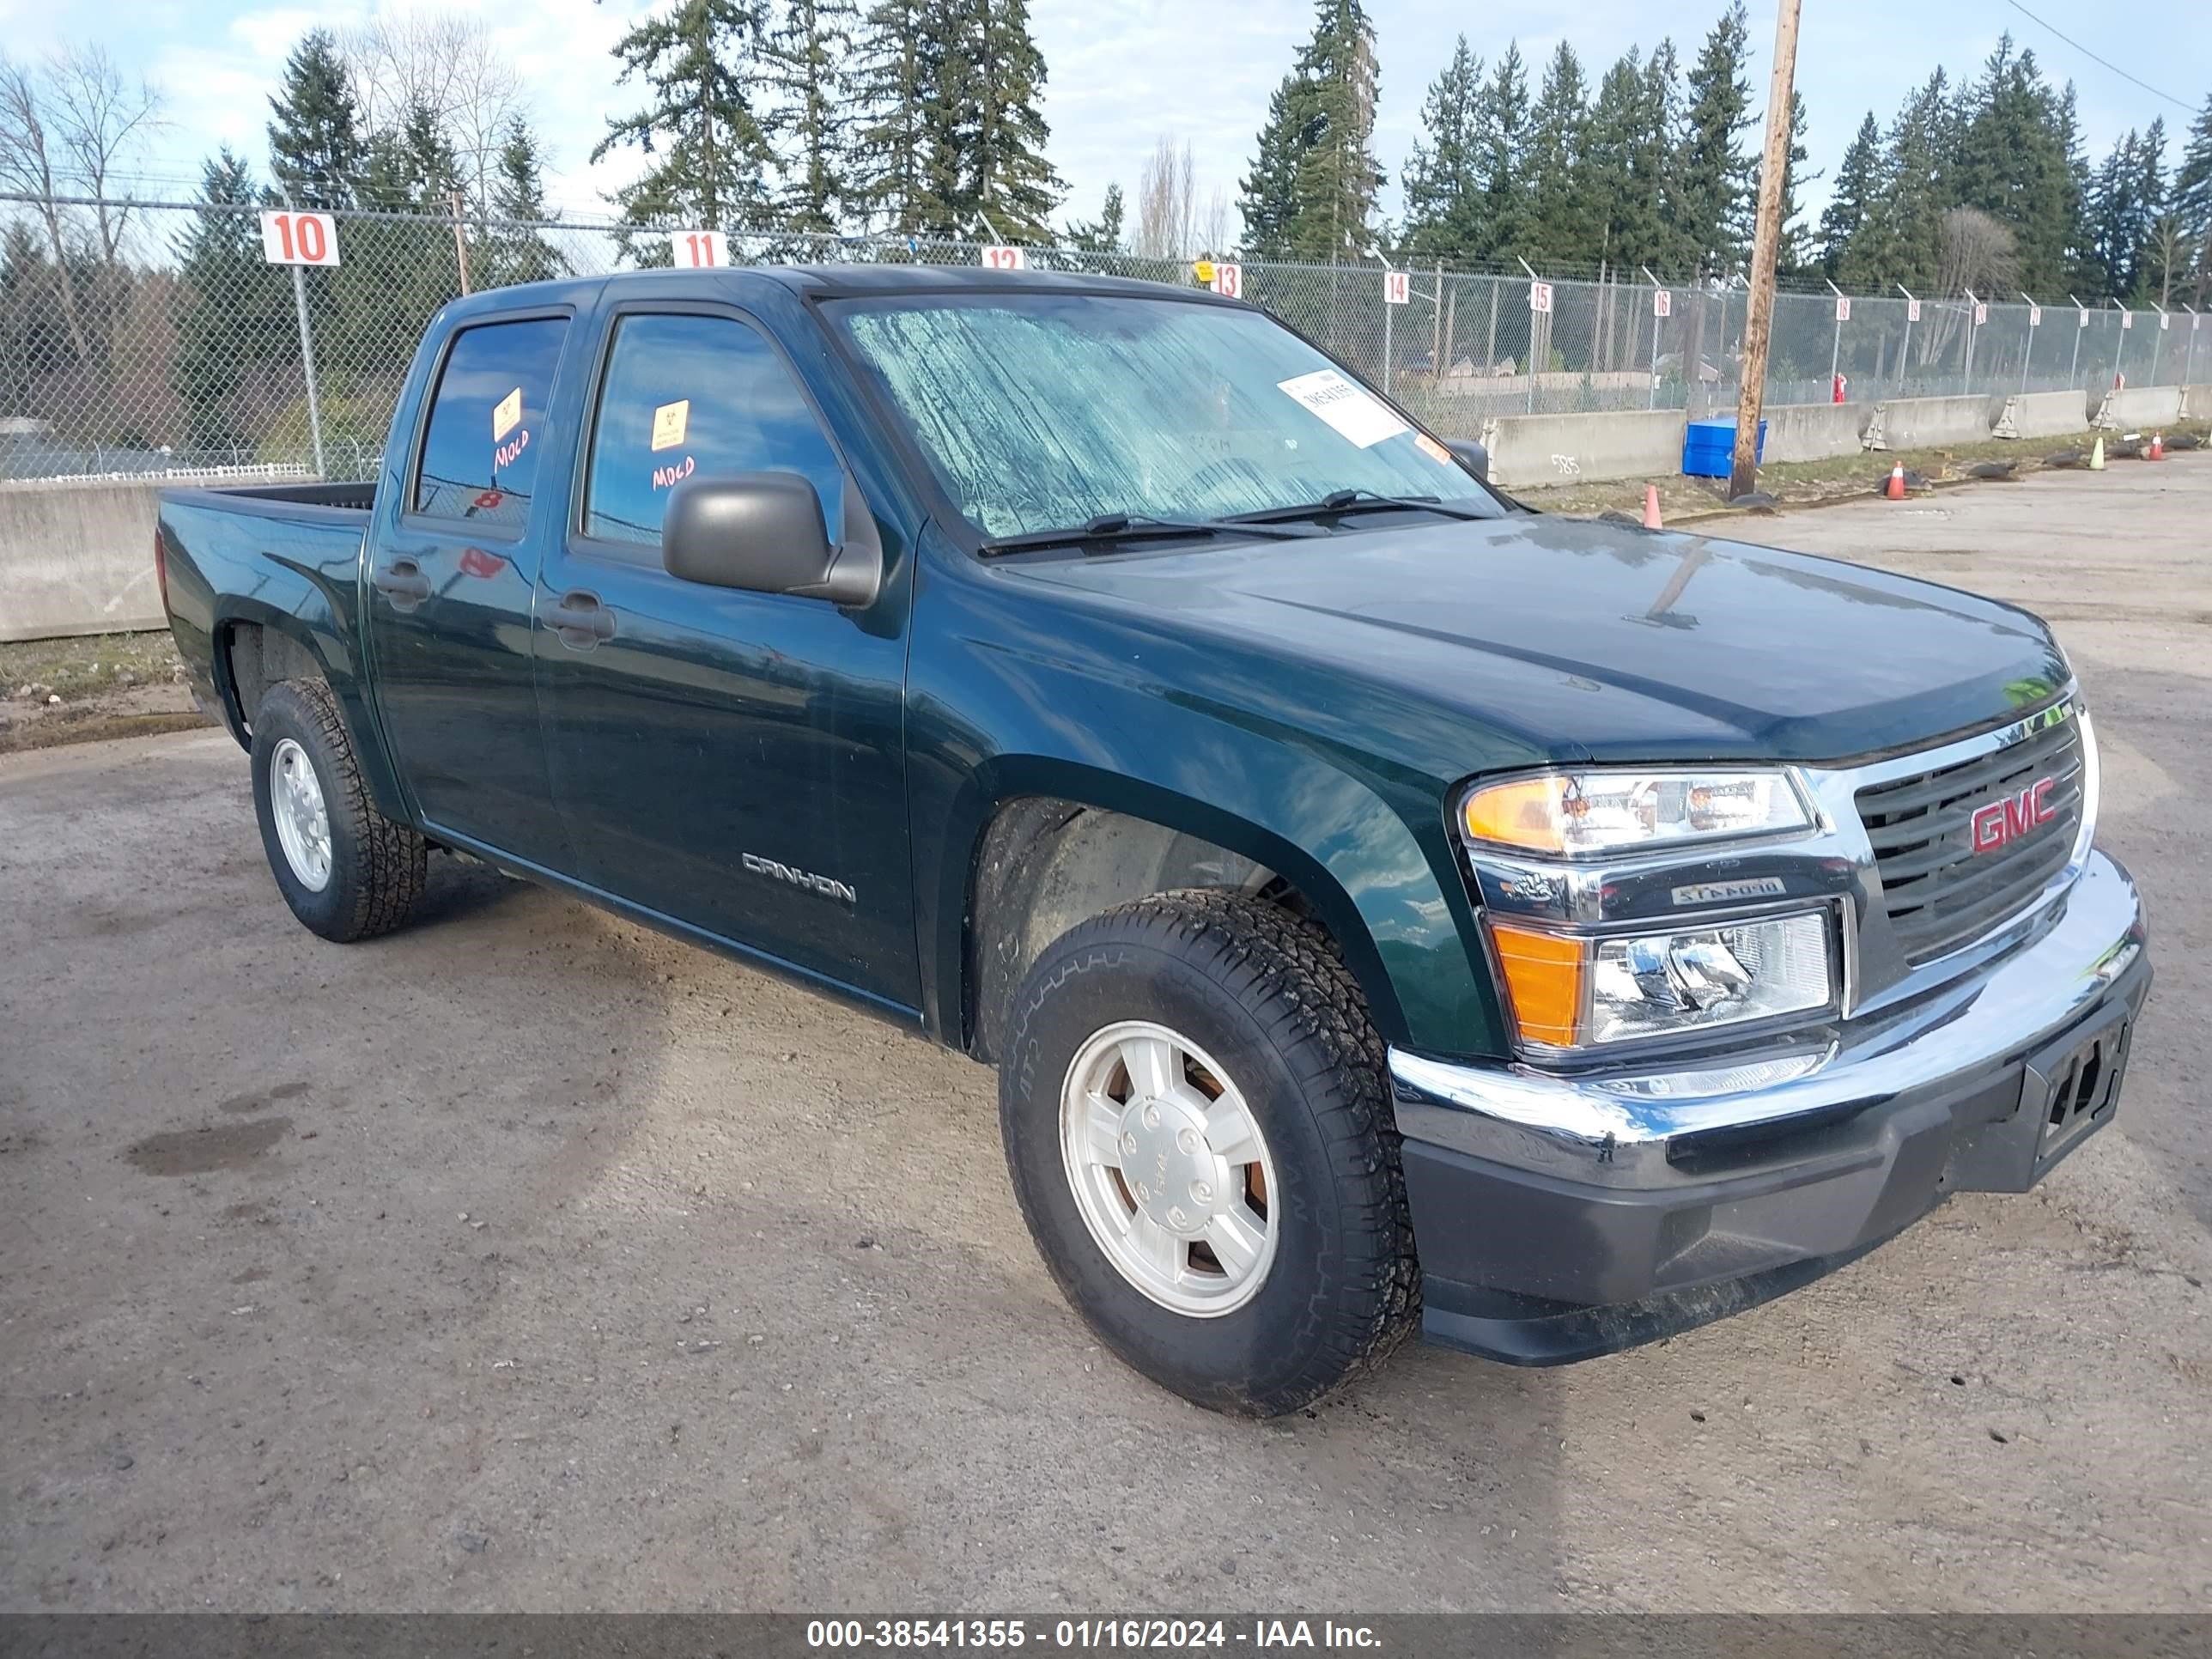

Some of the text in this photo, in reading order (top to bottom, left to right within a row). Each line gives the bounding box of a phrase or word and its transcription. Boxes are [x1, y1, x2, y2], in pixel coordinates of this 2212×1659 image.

[275, 215, 326, 261] 10
[687, 234, 714, 268] 11
[1217, 266, 1236, 296] 13
[1389, 275, 1405, 301] 14
[1535, 285, 1547, 309] 15
[1658, 293, 1668, 314] 16
[494, 429, 529, 475] MOLD
[653, 456, 695, 491] MOLD
[1971, 776, 2057, 852] GMC
[742, 852, 857, 902] CANYON
